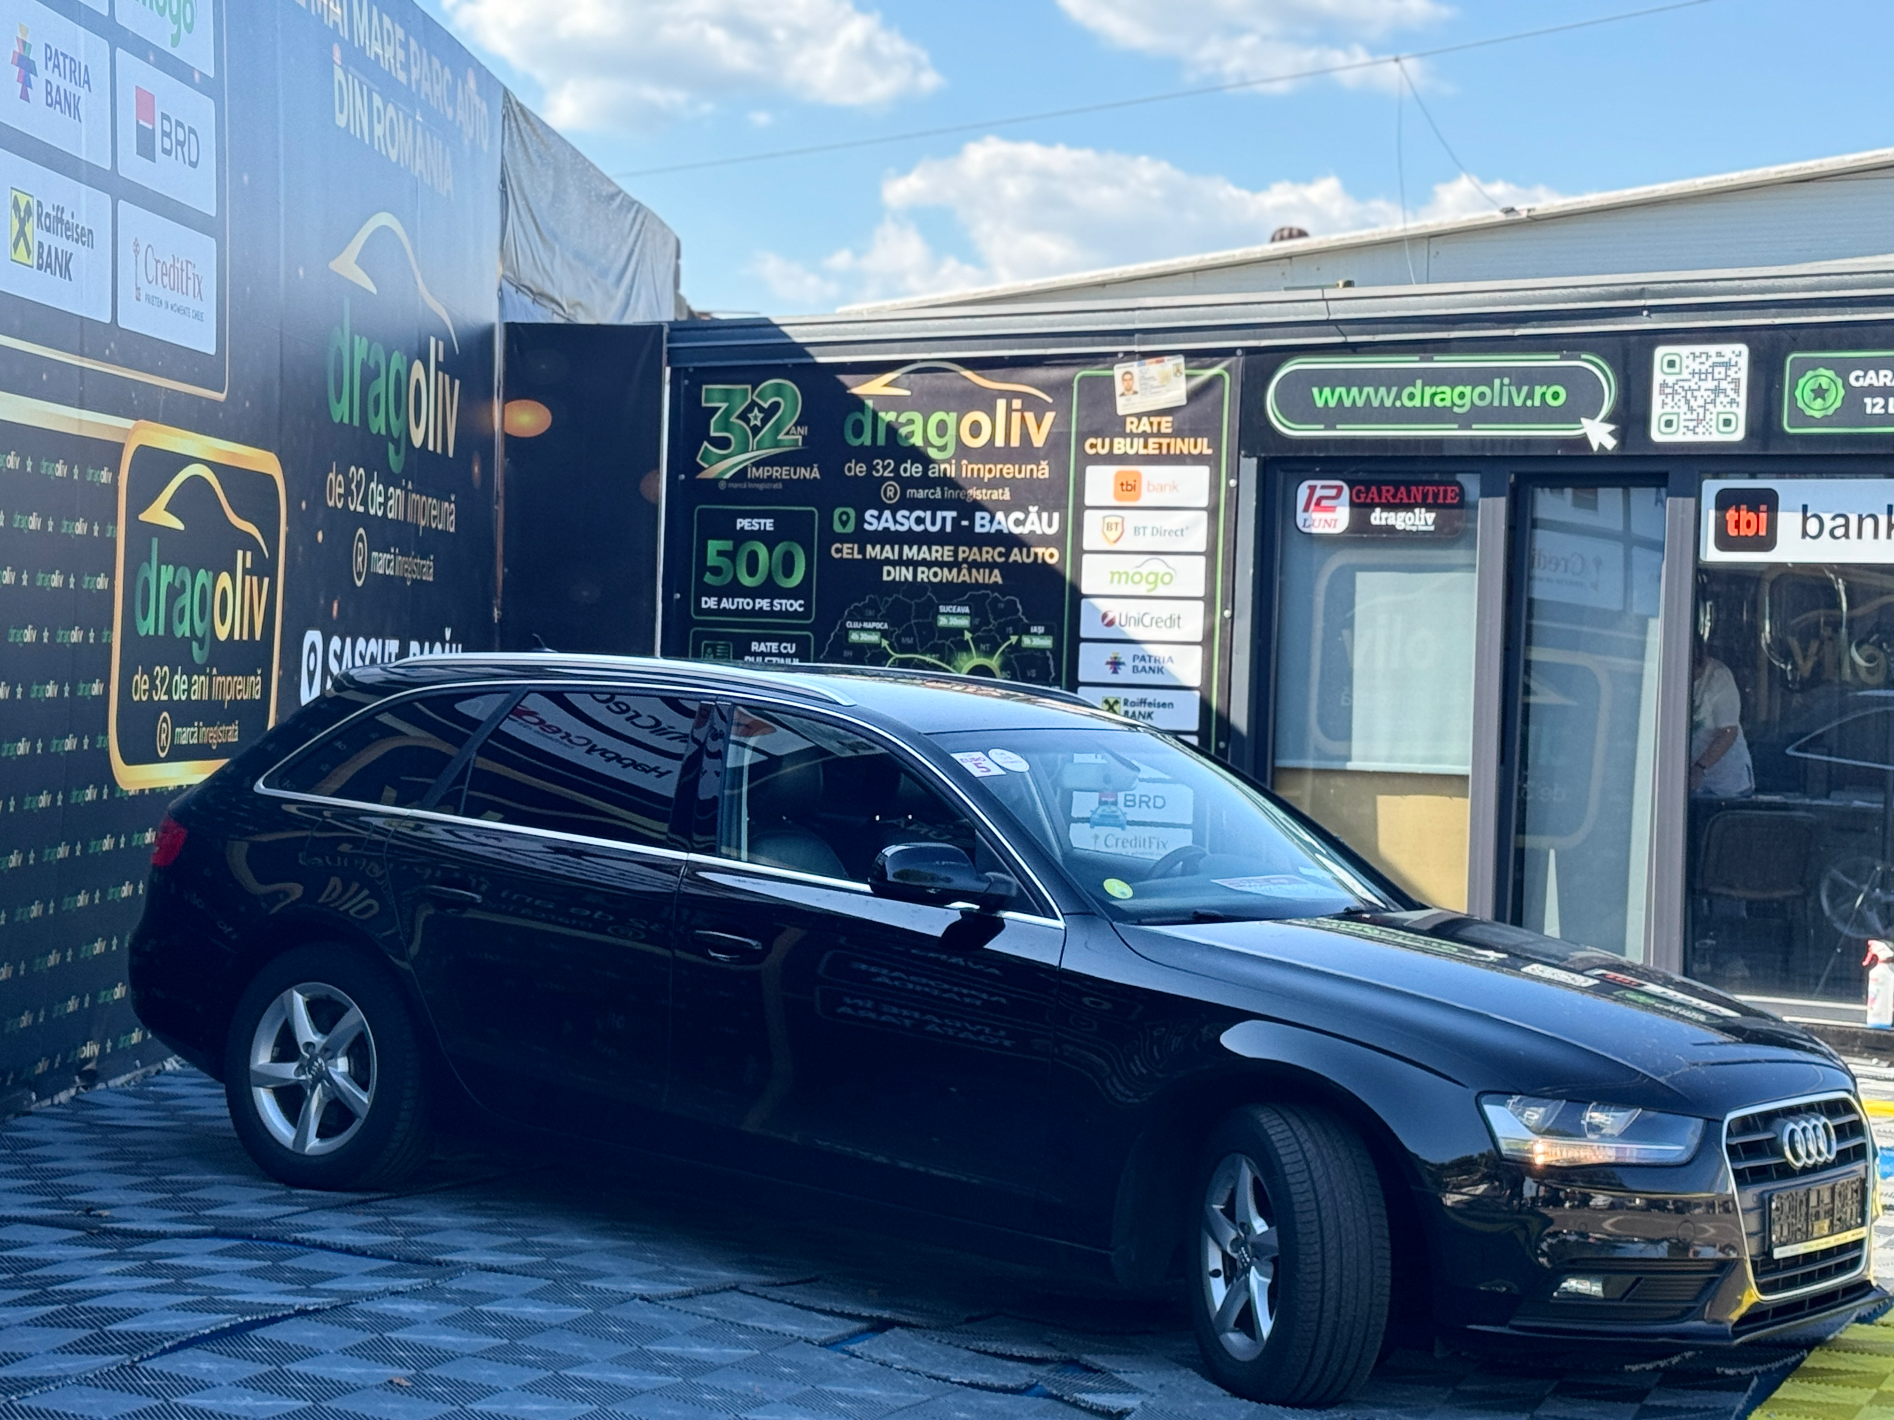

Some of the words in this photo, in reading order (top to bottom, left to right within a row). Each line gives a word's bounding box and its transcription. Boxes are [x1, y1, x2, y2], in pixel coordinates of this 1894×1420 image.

[137, 0, 195, 48] go
[44, 42, 92, 94] PATRIA
[352, 0, 408, 86] MARE
[408, 35, 454, 122] PARC
[45, 78, 82, 124] BANK
[333, 62, 369, 145] DIN
[160, 111, 200, 169] BRD
[36, 199, 95, 249] Raiffeisen
[36, 240, 74, 282] BANK
[144, 243, 204, 302] CreditFix
[326, 296, 461, 475] dragoliv
[1848, 369, 1894, 388] GAR
[1311, 377, 1567, 414] www.dragoliv.ro
[1863, 396, 1886, 414] 12
[696, 378, 802, 469] 32
[788, 425, 808, 436] ANI
[844, 398, 1057, 460] dragoliv
[1125, 416, 1173, 434] RATE
[1084, 437, 1110, 455] CU
[1112, 437, 1213, 455] BULETINUL
[747, 463, 821, 479] ÎMPREUNĂ
[844, 459, 867, 477] de
[872, 459, 895, 477] 32
[899, 459, 923, 477] de
[927, 459, 956, 478] ani
[961, 459, 1050, 482] împreună
[906, 487, 942, 500] marcă
[944, 486, 1011, 502] înregistrată
[1119, 479, 1137, 492] tbi
[1147, 481, 1179, 493] bank
[1352, 485, 1460, 504] GARANTIE
[326, 461, 345, 509] de
[348, 465, 366, 513] 32
[368, 471, 385, 517] de
[387, 479, 405, 521] ani
[407, 481, 456, 536] împreună
[1302, 485, 1344, 513] 12
[736, 518, 774, 531] PESTE
[863, 509, 957, 533] SASCUT
[974, 505, 1060, 535] BACĂU
[1106, 521, 1120, 532] BT
[1302, 517, 1338, 529] LUNI
[1370, 507, 1436, 531] dragoliv
[1725, 504, 1768, 537] tbi
[1133, 526, 1148, 537] BT
[370, 547, 395, 575] marcă
[830, 543, 863, 559] CEL
[866, 544, 899, 560] MAI
[902, 545, 955, 562] MARE
[958, 546, 1006, 563] PARC
[1008, 547, 1060, 564] AUTO
[703, 539, 806, 589] 500
[882, 565, 914, 582] DIN
[917, 564, 1003, 584] ROMÂNIA
[1109, 570, 1174, 593] mogo
[134, 537, 270, 664] dragoliv
[701, 597, 718, 609] DE
[720, 598, 753, 610] AUTO
[755, 598, 772, 611] PE
[773, 599, 805, 612] STOC
[938, 605, 970, 614] SUCEAVA
[845, 621, 889, 630] CLUJ-NAPOCA
[1118, 612, 1182, 629] UniCredit
[751, 641, 779, 653] RATE
[780, 642, 796, 654] CU
[1132, 654, 1174, 664] PATRIA
[1132, 666, 1164, 675] BANK
[132, 665, 149, 701] de
[152, 665, 170, 701] 32
[172, 665, 189, 701] de
[191, 667, 209, 701] ani
[211, 667, 262, 710] împreună
[1123, 698, 1174, 709] Raiffeisen
[1123, 710, 1154, 721] BANK
[972, 762, 992, 773] 5
[1123, 793, 1167, 809] BRD
[1104, 833, 1169, 851] CreditFix
